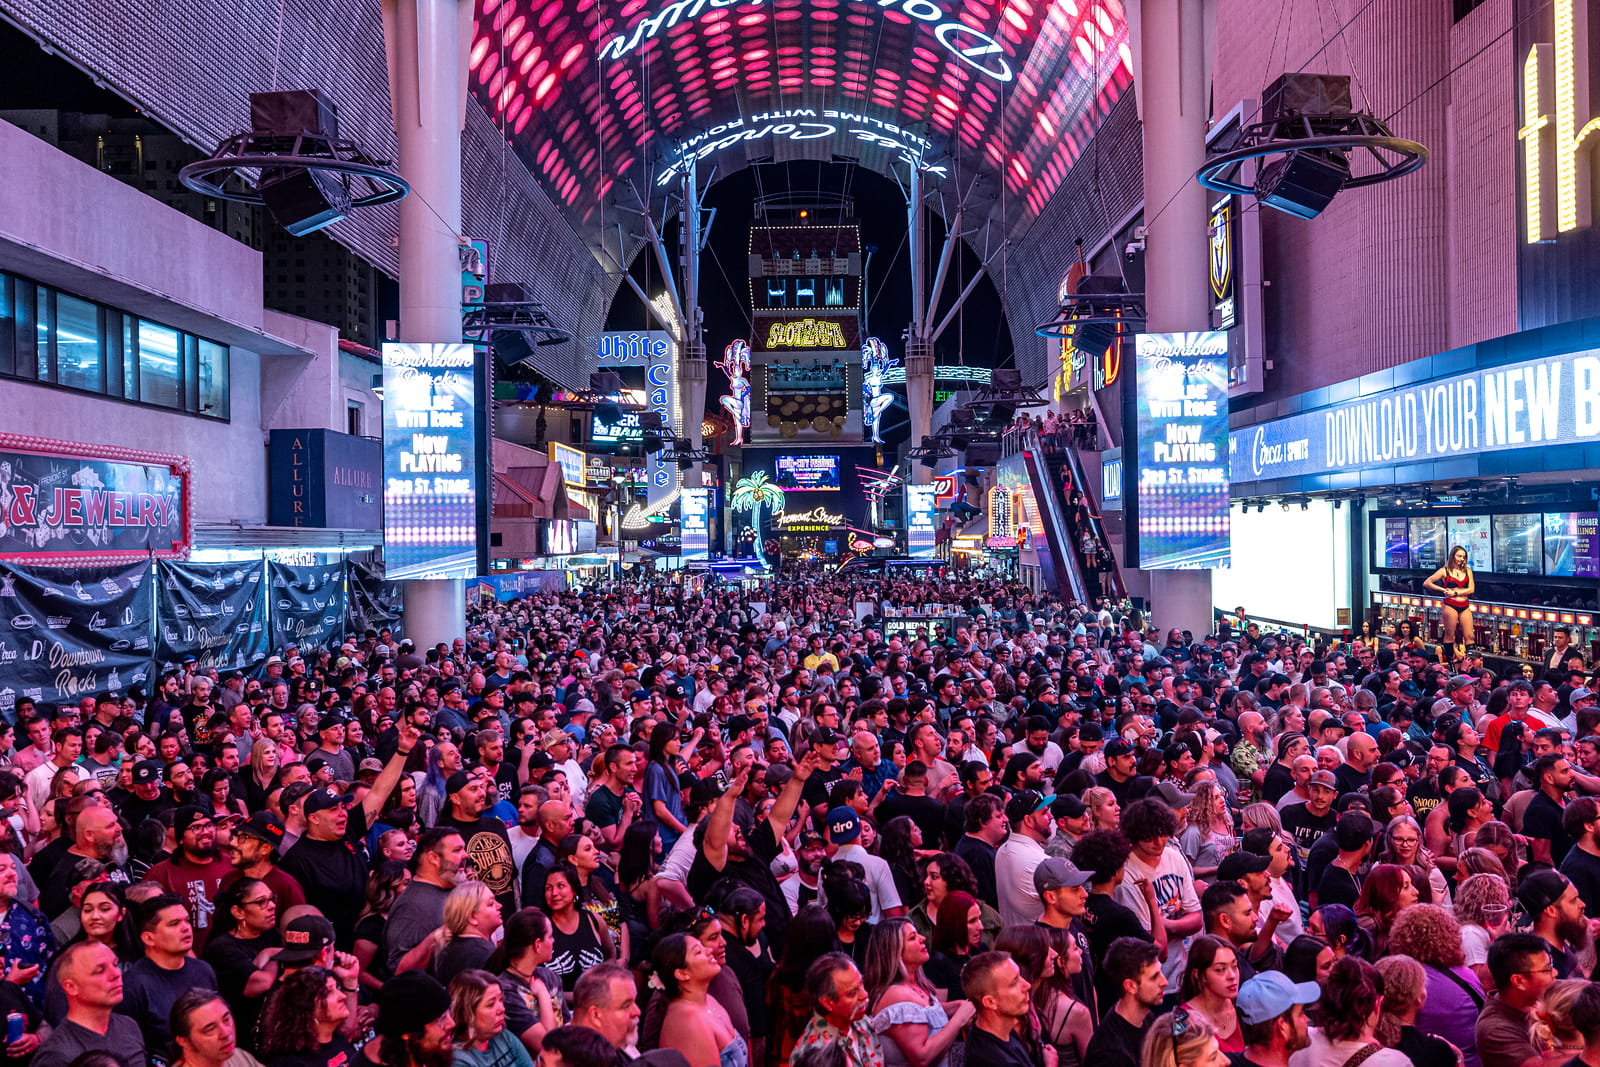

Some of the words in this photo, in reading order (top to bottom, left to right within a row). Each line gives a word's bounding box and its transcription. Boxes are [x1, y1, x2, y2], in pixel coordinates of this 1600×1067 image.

[751, 109, 816, 123] WITH
[767, 319, 847, 349] SLOTZILLA
[395, 411, 428, 428] WITH
[430, 411, 464, 428] ROME
[1149, 400, 1182, 418] WITH
[1184, 400, 1217, 417] ROME
[1253, 426, 1283, 476] Circa
[1287, 438, 1309, 461] SPORTS
[1325, 393, 1417, 467] DOWNLOAD
[1421, 378, 1478, 454] YOUR
[1484, 362, 1561, 446] NEW
[413, 434, 448, 454] NOW
[1165, 424, 1202, 444] NOW
[1154, 442, 1216, 463] PLAYING
[400, 454, 462, 473] PLAYING
[334, 466, 373, 489] ALLURE
[10, 485, 37, 526] &
[46, 487, 174, 528] JEWELRY
[773, 510, 813, 529] Fremont
[812, 506, 843, 526] Street
[49, 641, 105, 669] Downtown
[55, 668, 97, 698] Rocks
[837, 820, 853, 833] dro
